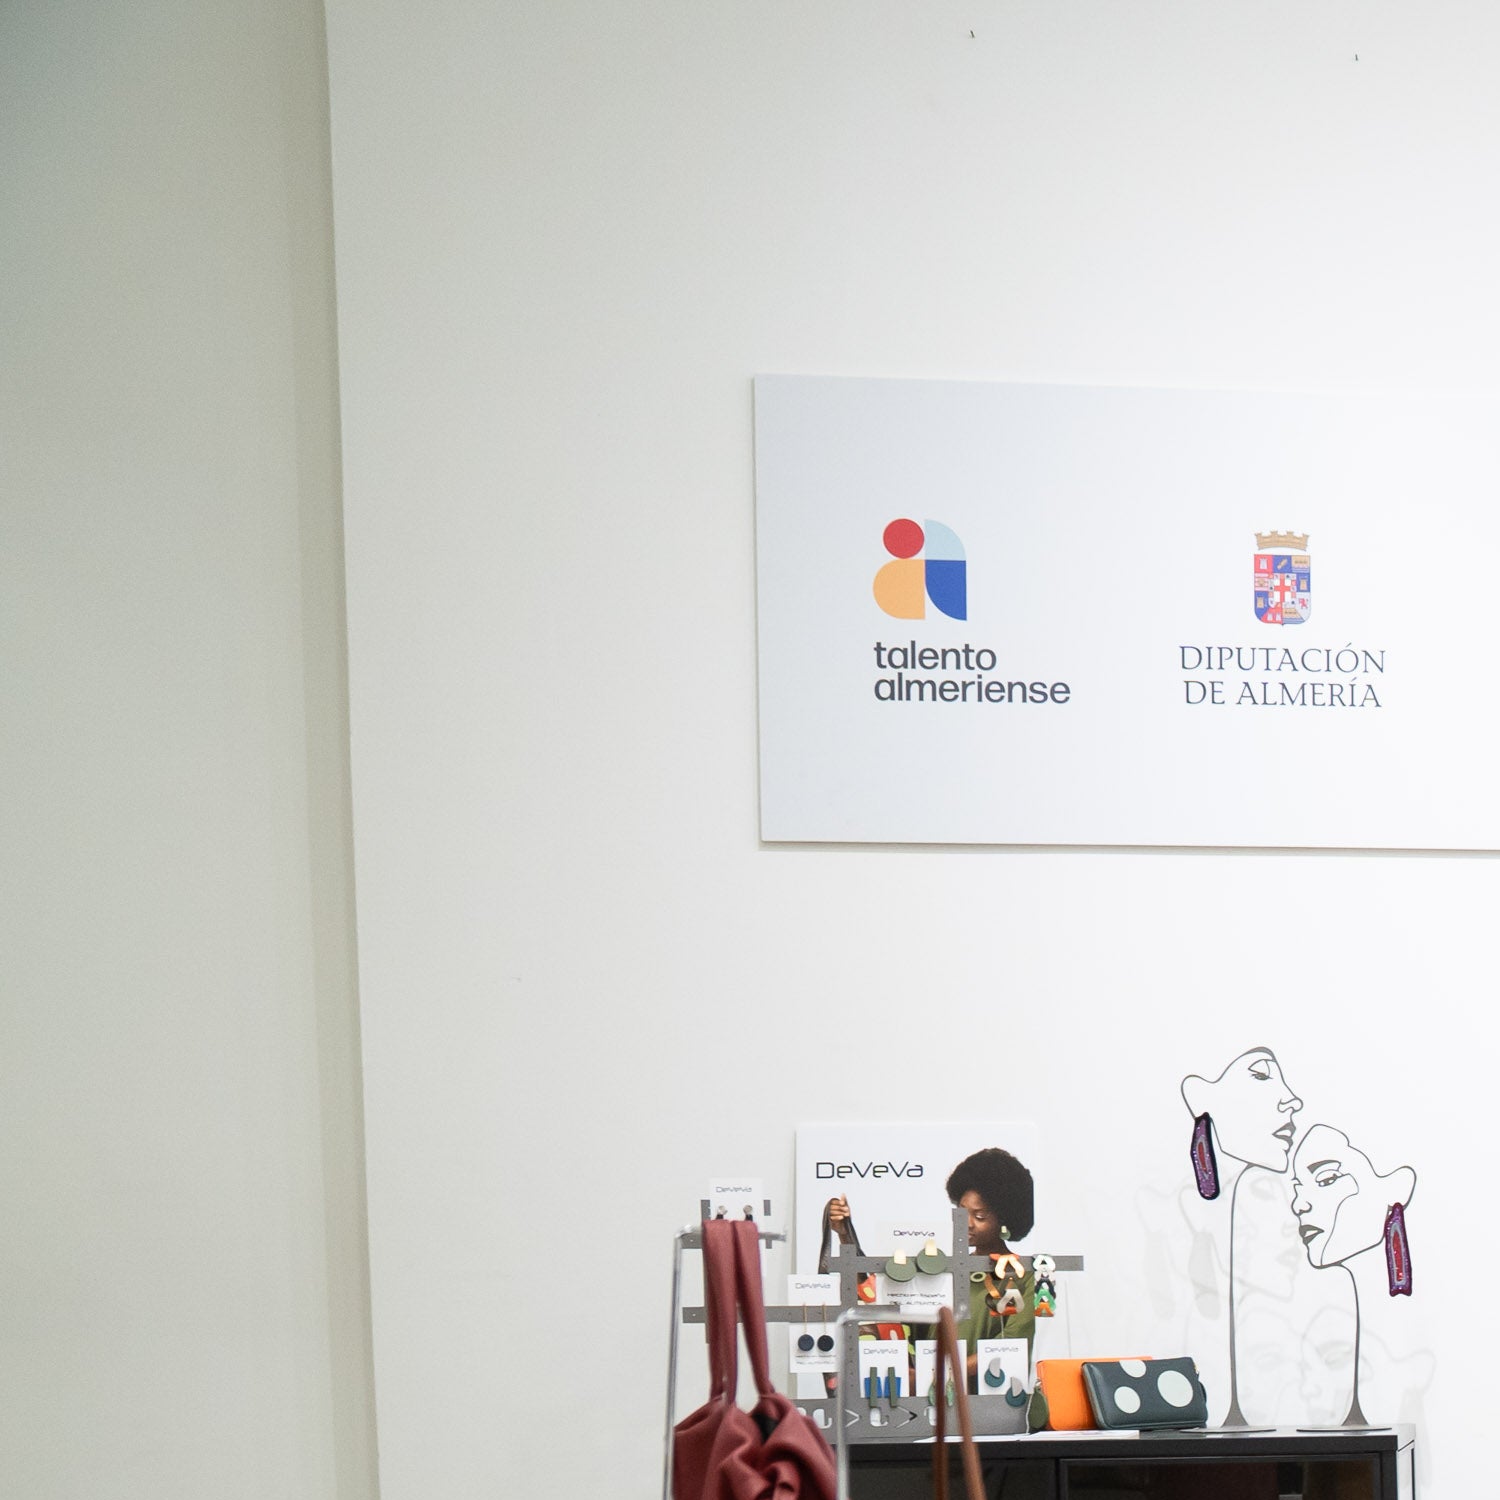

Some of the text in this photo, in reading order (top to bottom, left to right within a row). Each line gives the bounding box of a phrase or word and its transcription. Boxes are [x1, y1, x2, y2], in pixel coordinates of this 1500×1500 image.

[873, 640, 997, 671] talento
[1179, 643, 1385, 673] DIPUTACIÓN
[873, 672, 1071, 704] almeriense
[1184, 672, 1383, 707] DE ALMERÍA
[816, 1162, 924, 1179] DeVeVa
